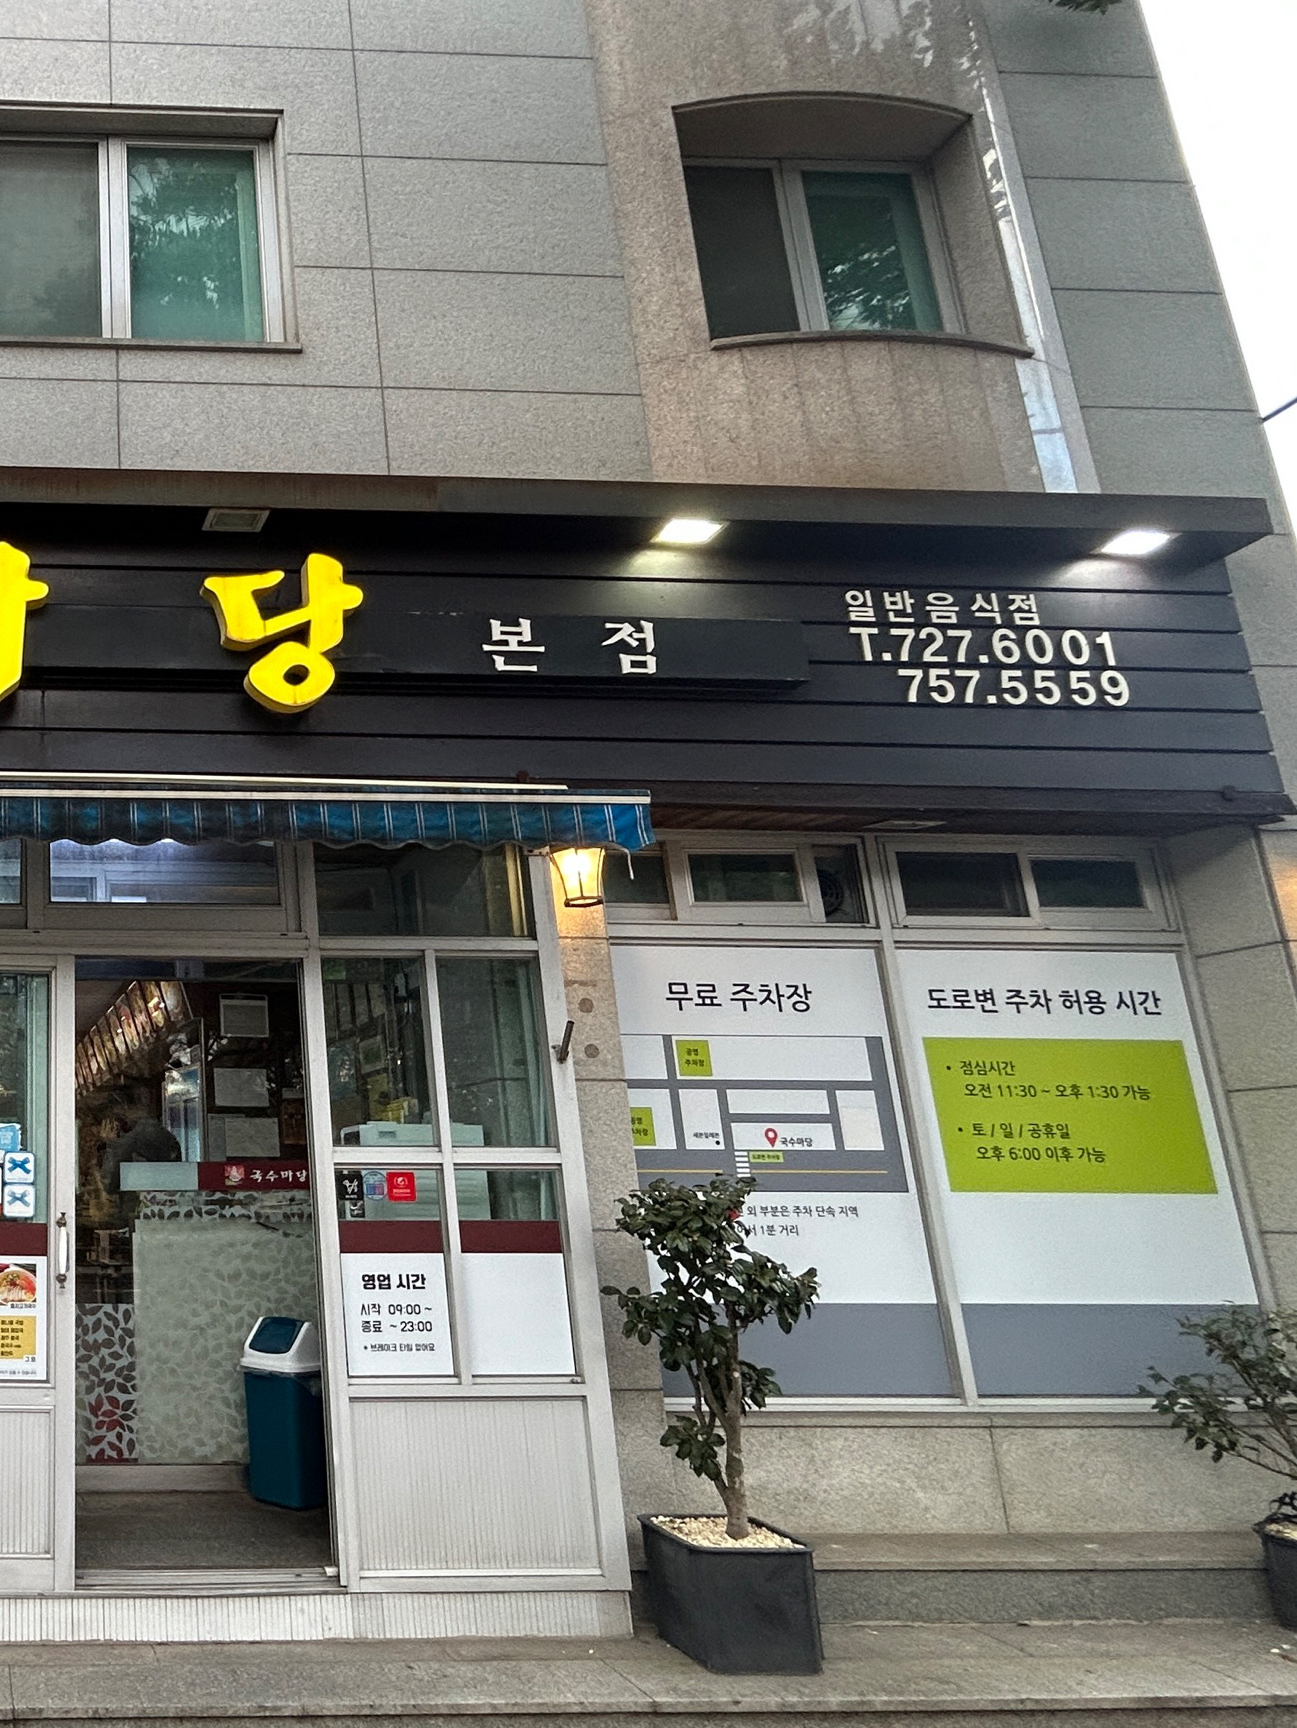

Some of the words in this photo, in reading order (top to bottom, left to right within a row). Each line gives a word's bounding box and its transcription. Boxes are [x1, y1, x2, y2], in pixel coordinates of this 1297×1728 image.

[845, 589, 1040, 625] 일반음식점
[848, 627, 1117, 667] T.727.6001
[896, 668, 1131, 708] 757.5559
[665, 982, 722, 1011] 무료
[730, 982, 812, 1012] 주차장
[927, 988, 999, 1013] 도로변
[1005, 988, 1052, 1014] 주차
[1058, 989, 1107, 1015] 허용
[1116, 990, 1162, 1015] 시간
[960, 1060, 1016, 1076] 점심시간
[964, 1083, 992, 1098] 오전
[997, 1085, 1037, 1098] 11:30
[1055, 1084, 1084, 1099] 오후
[1088, 1085, 1119, 1098] 1:30
[1123, 1085, 1151, 1100] 가능
[972, 1123, 986, 1136] 토
[1000, 1123, 1014, 1139] 일
[1027, 1123, 1070, 1139] 공휴일
[779, 1137, 813, 1147] 국수마당
[977, 1146, 1005, 1161] 오후
[1009, 1147, 1041, 1160] 6:00
[1046, 1147, 1073, 1162] 이후
[1078, 1147, 1106, 1163] 가능
[249, 1168, 308, 1184] 국수마당
[746, 1206, 757, 1217] 외
[759, 1205, 791, 1217] 부분은
[793, 1205, 813, 1217] 주차
[815, 1206, 836, 1218] 단속
[838, 1206, 859, 1218] 지역
[760, 1225, 776, 1236] 1분
[779, 1225, 799, 1236] 거리
[361, 1274, 391, 1290] 영업
[396, 1273, 426, 1290] 시간
[360, 1303, 381, 1315] 시작
[388, 1303, 421, 1315] 09:00
[361, 1320, 383, 1333] 종료
[400, 1320, 433, 1332] 23:00
[370, 1343, 397, 1352] 브레이크
[399, 1343, 413, 1352] 타임
[415, 1343, 436, 1352] 없어요
